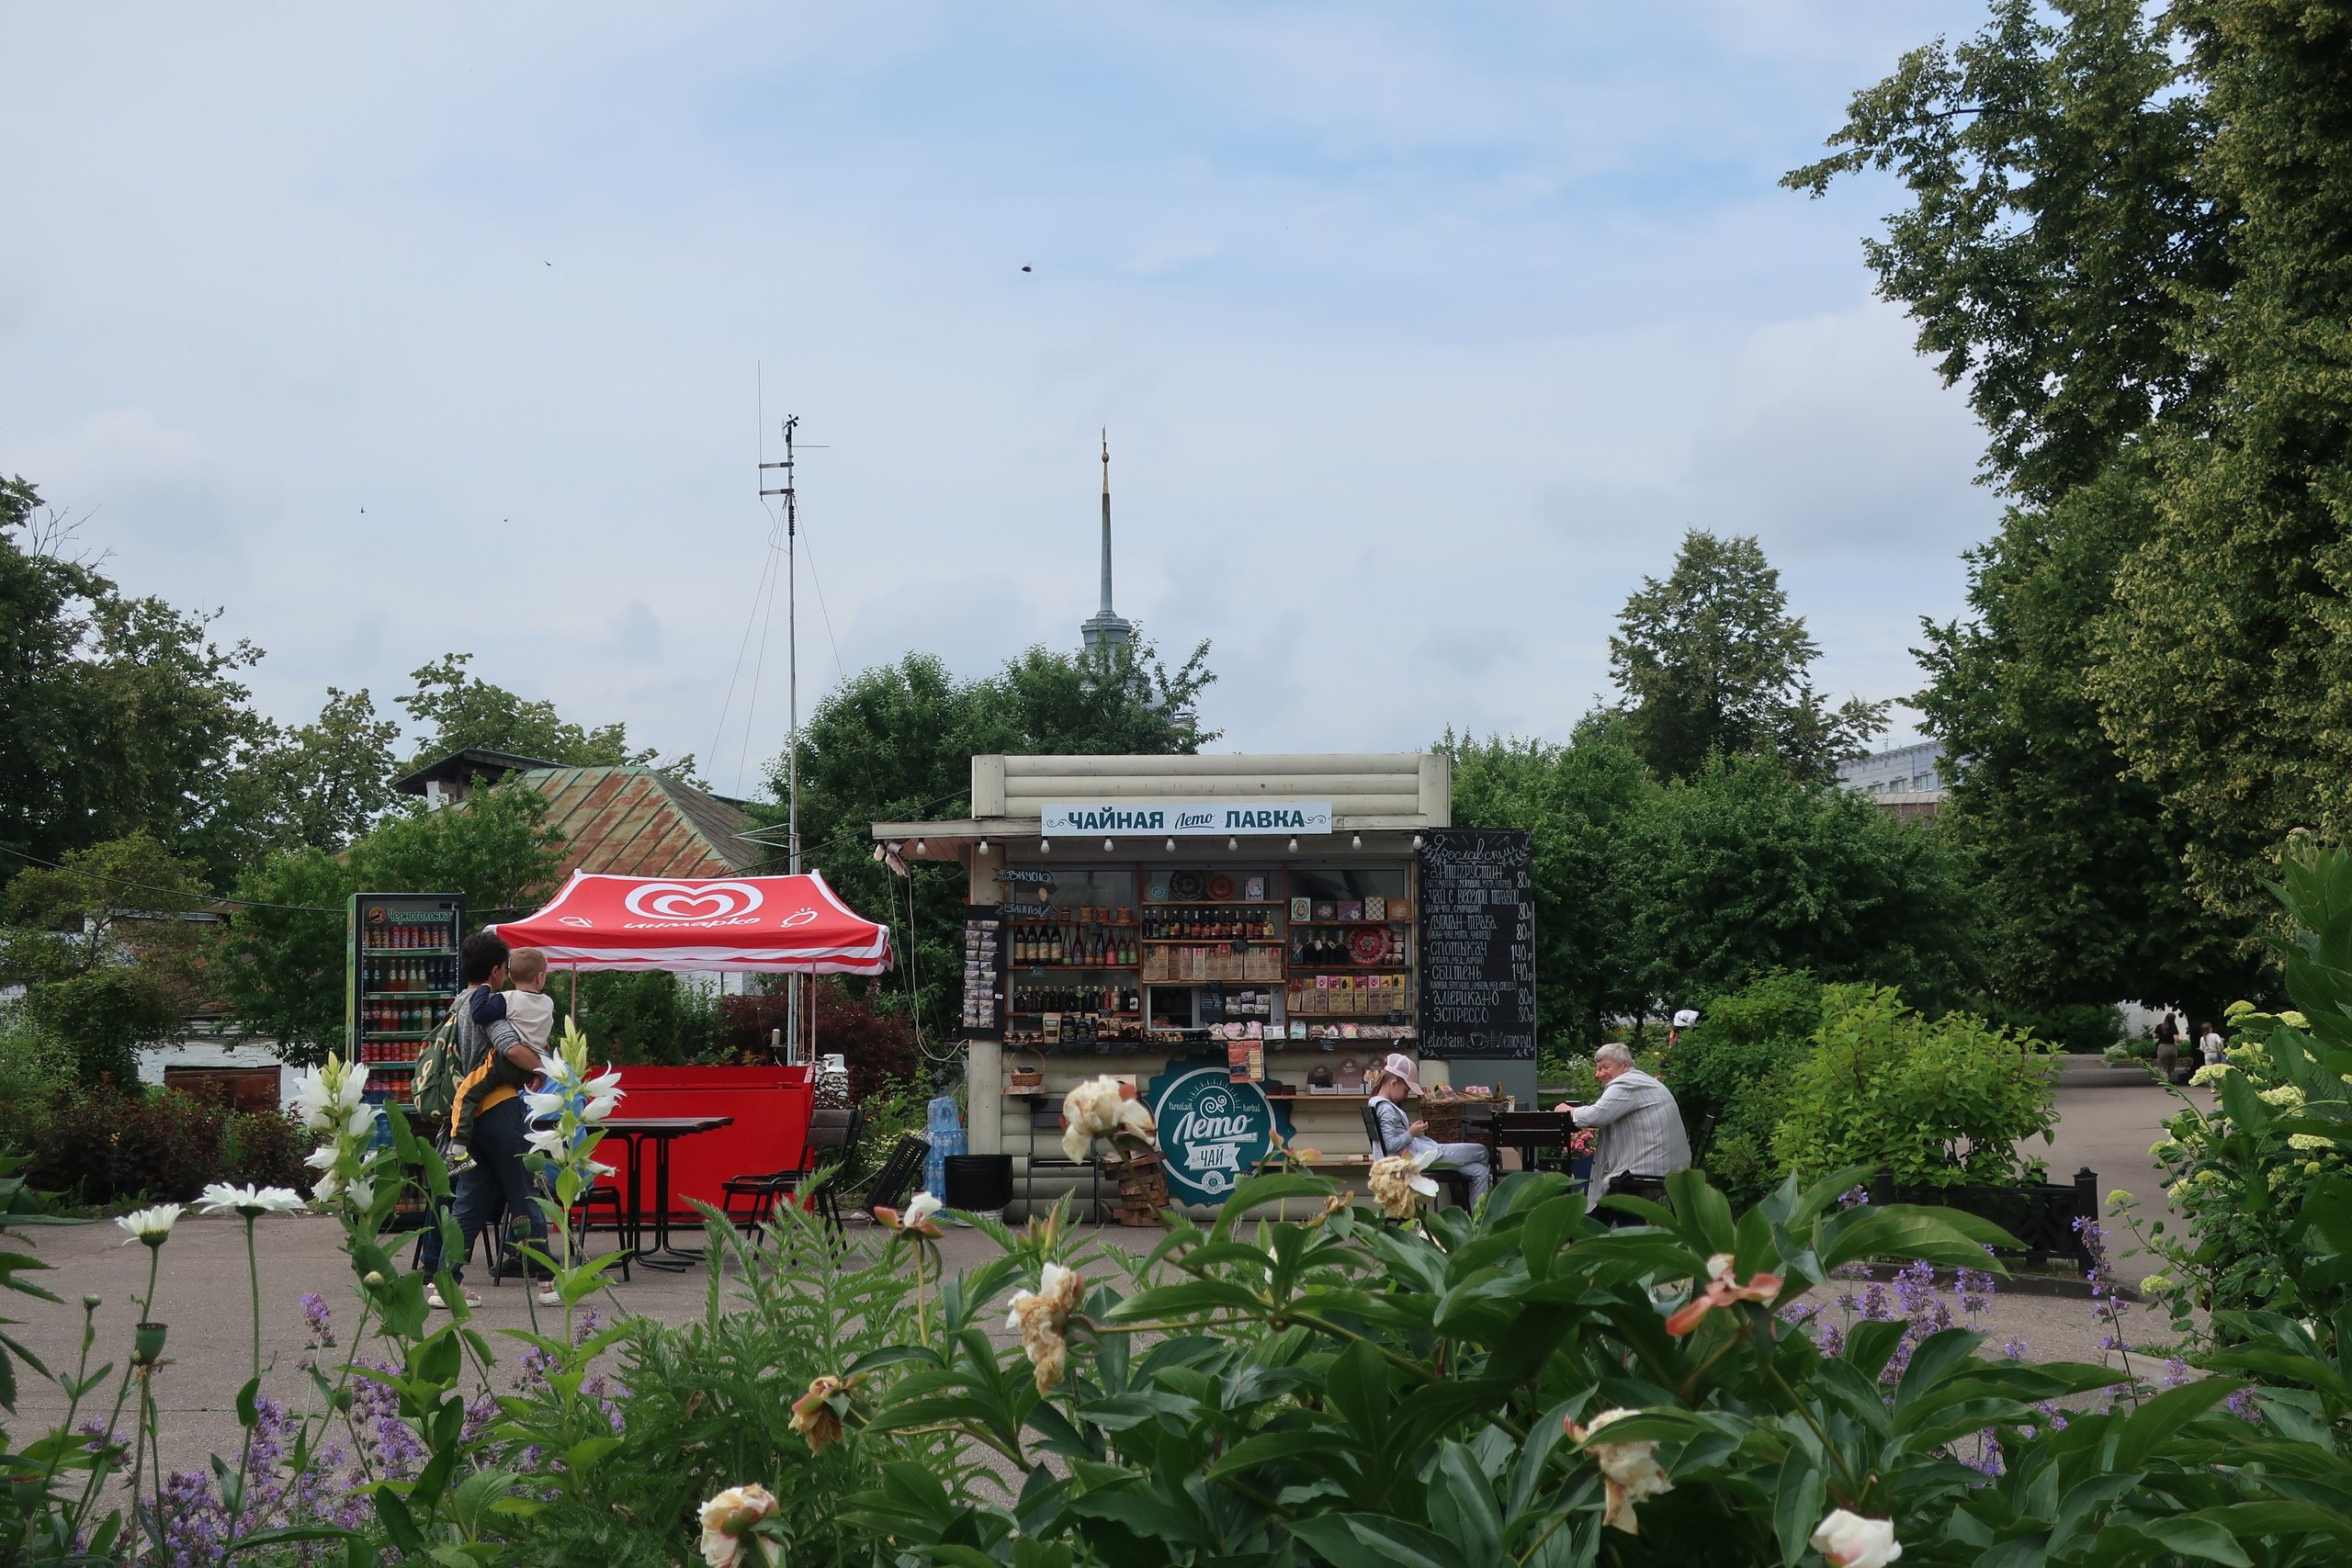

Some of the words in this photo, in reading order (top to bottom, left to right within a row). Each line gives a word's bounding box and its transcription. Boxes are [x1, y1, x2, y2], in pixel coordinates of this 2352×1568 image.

[1068, 806, 1164, 829] ЧАЙНАЯ
[1174, 812, 1216, 829] Лето
[1225, 810, 1306, 829] ЛАВКА
[1430, 834, 1519, 861] Ярославский
[387, 908, 451, 925] Черноголовка
[623, 917, 762, 930] инмарко
[1168, 1101, 1193, 1111] Yaroslavl
[1242, 1103, 1261, 1112] herbal
[1172, 1111, 1254, 1145] Лето
[1200, 1145, 1225, 1168] ЧАЙ
